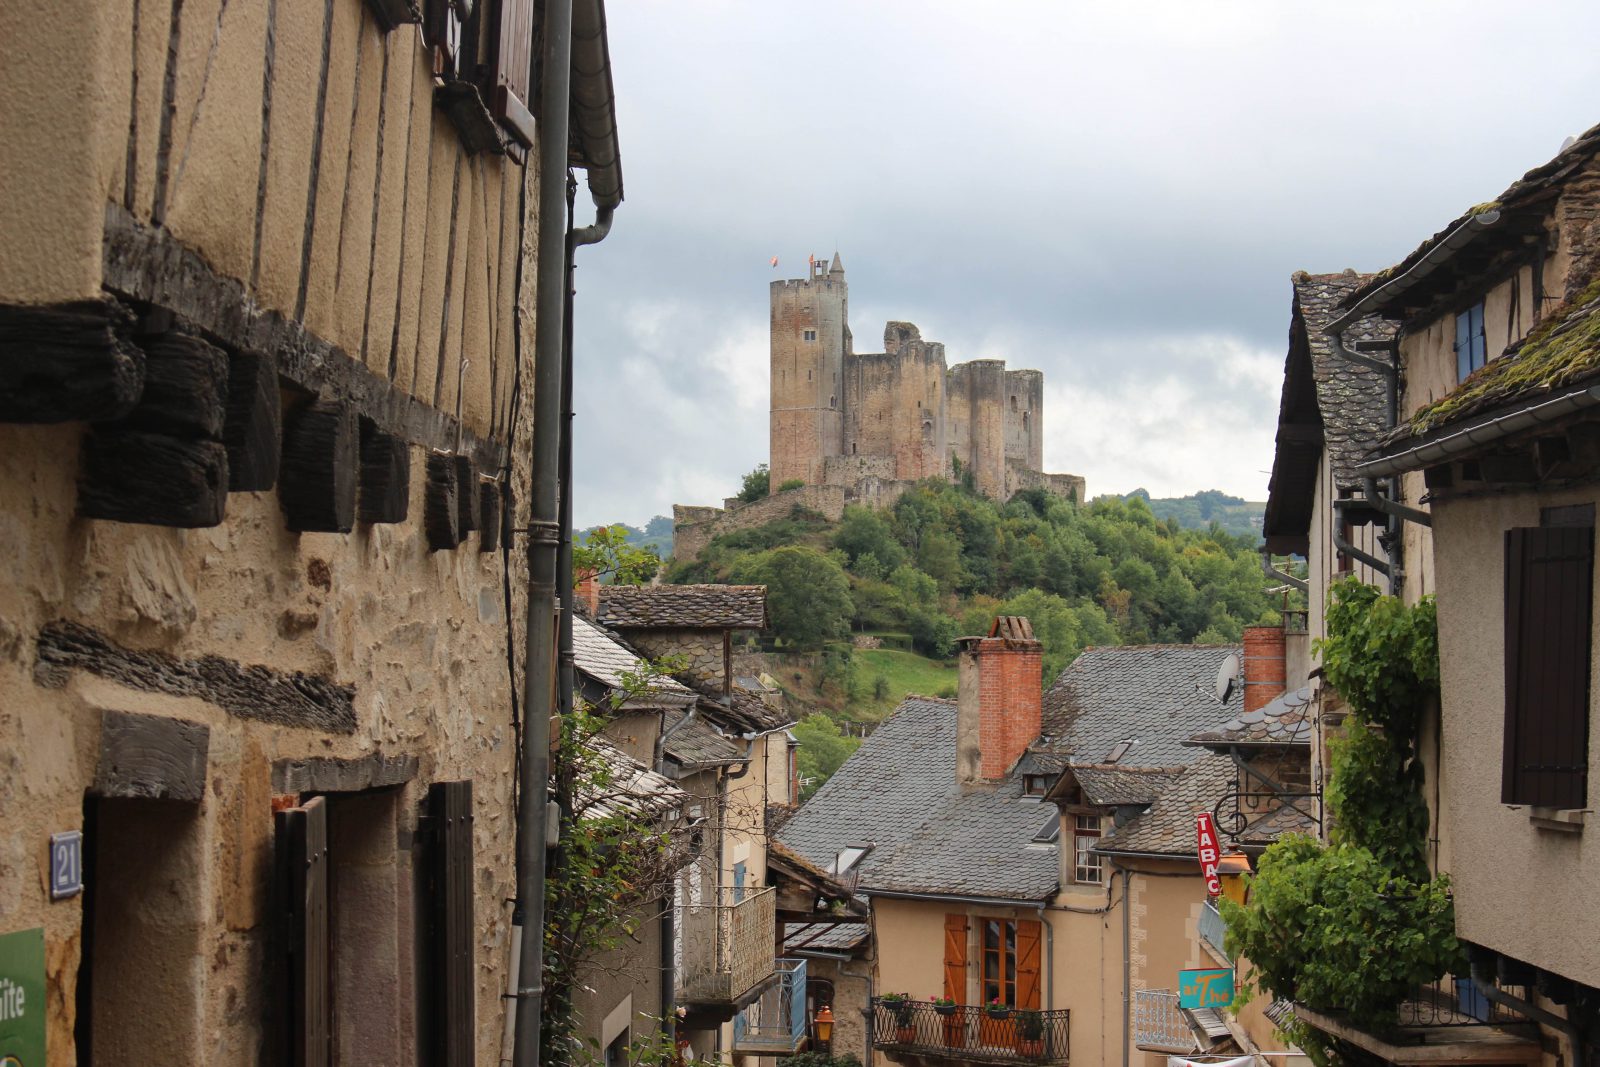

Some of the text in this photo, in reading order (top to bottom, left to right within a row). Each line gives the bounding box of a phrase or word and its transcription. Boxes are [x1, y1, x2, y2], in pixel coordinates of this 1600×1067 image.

[58, 843, 76, 886] 21
[1198, 817, 1219, 893] TABAC
[0, 978, 25, 1021] îte
